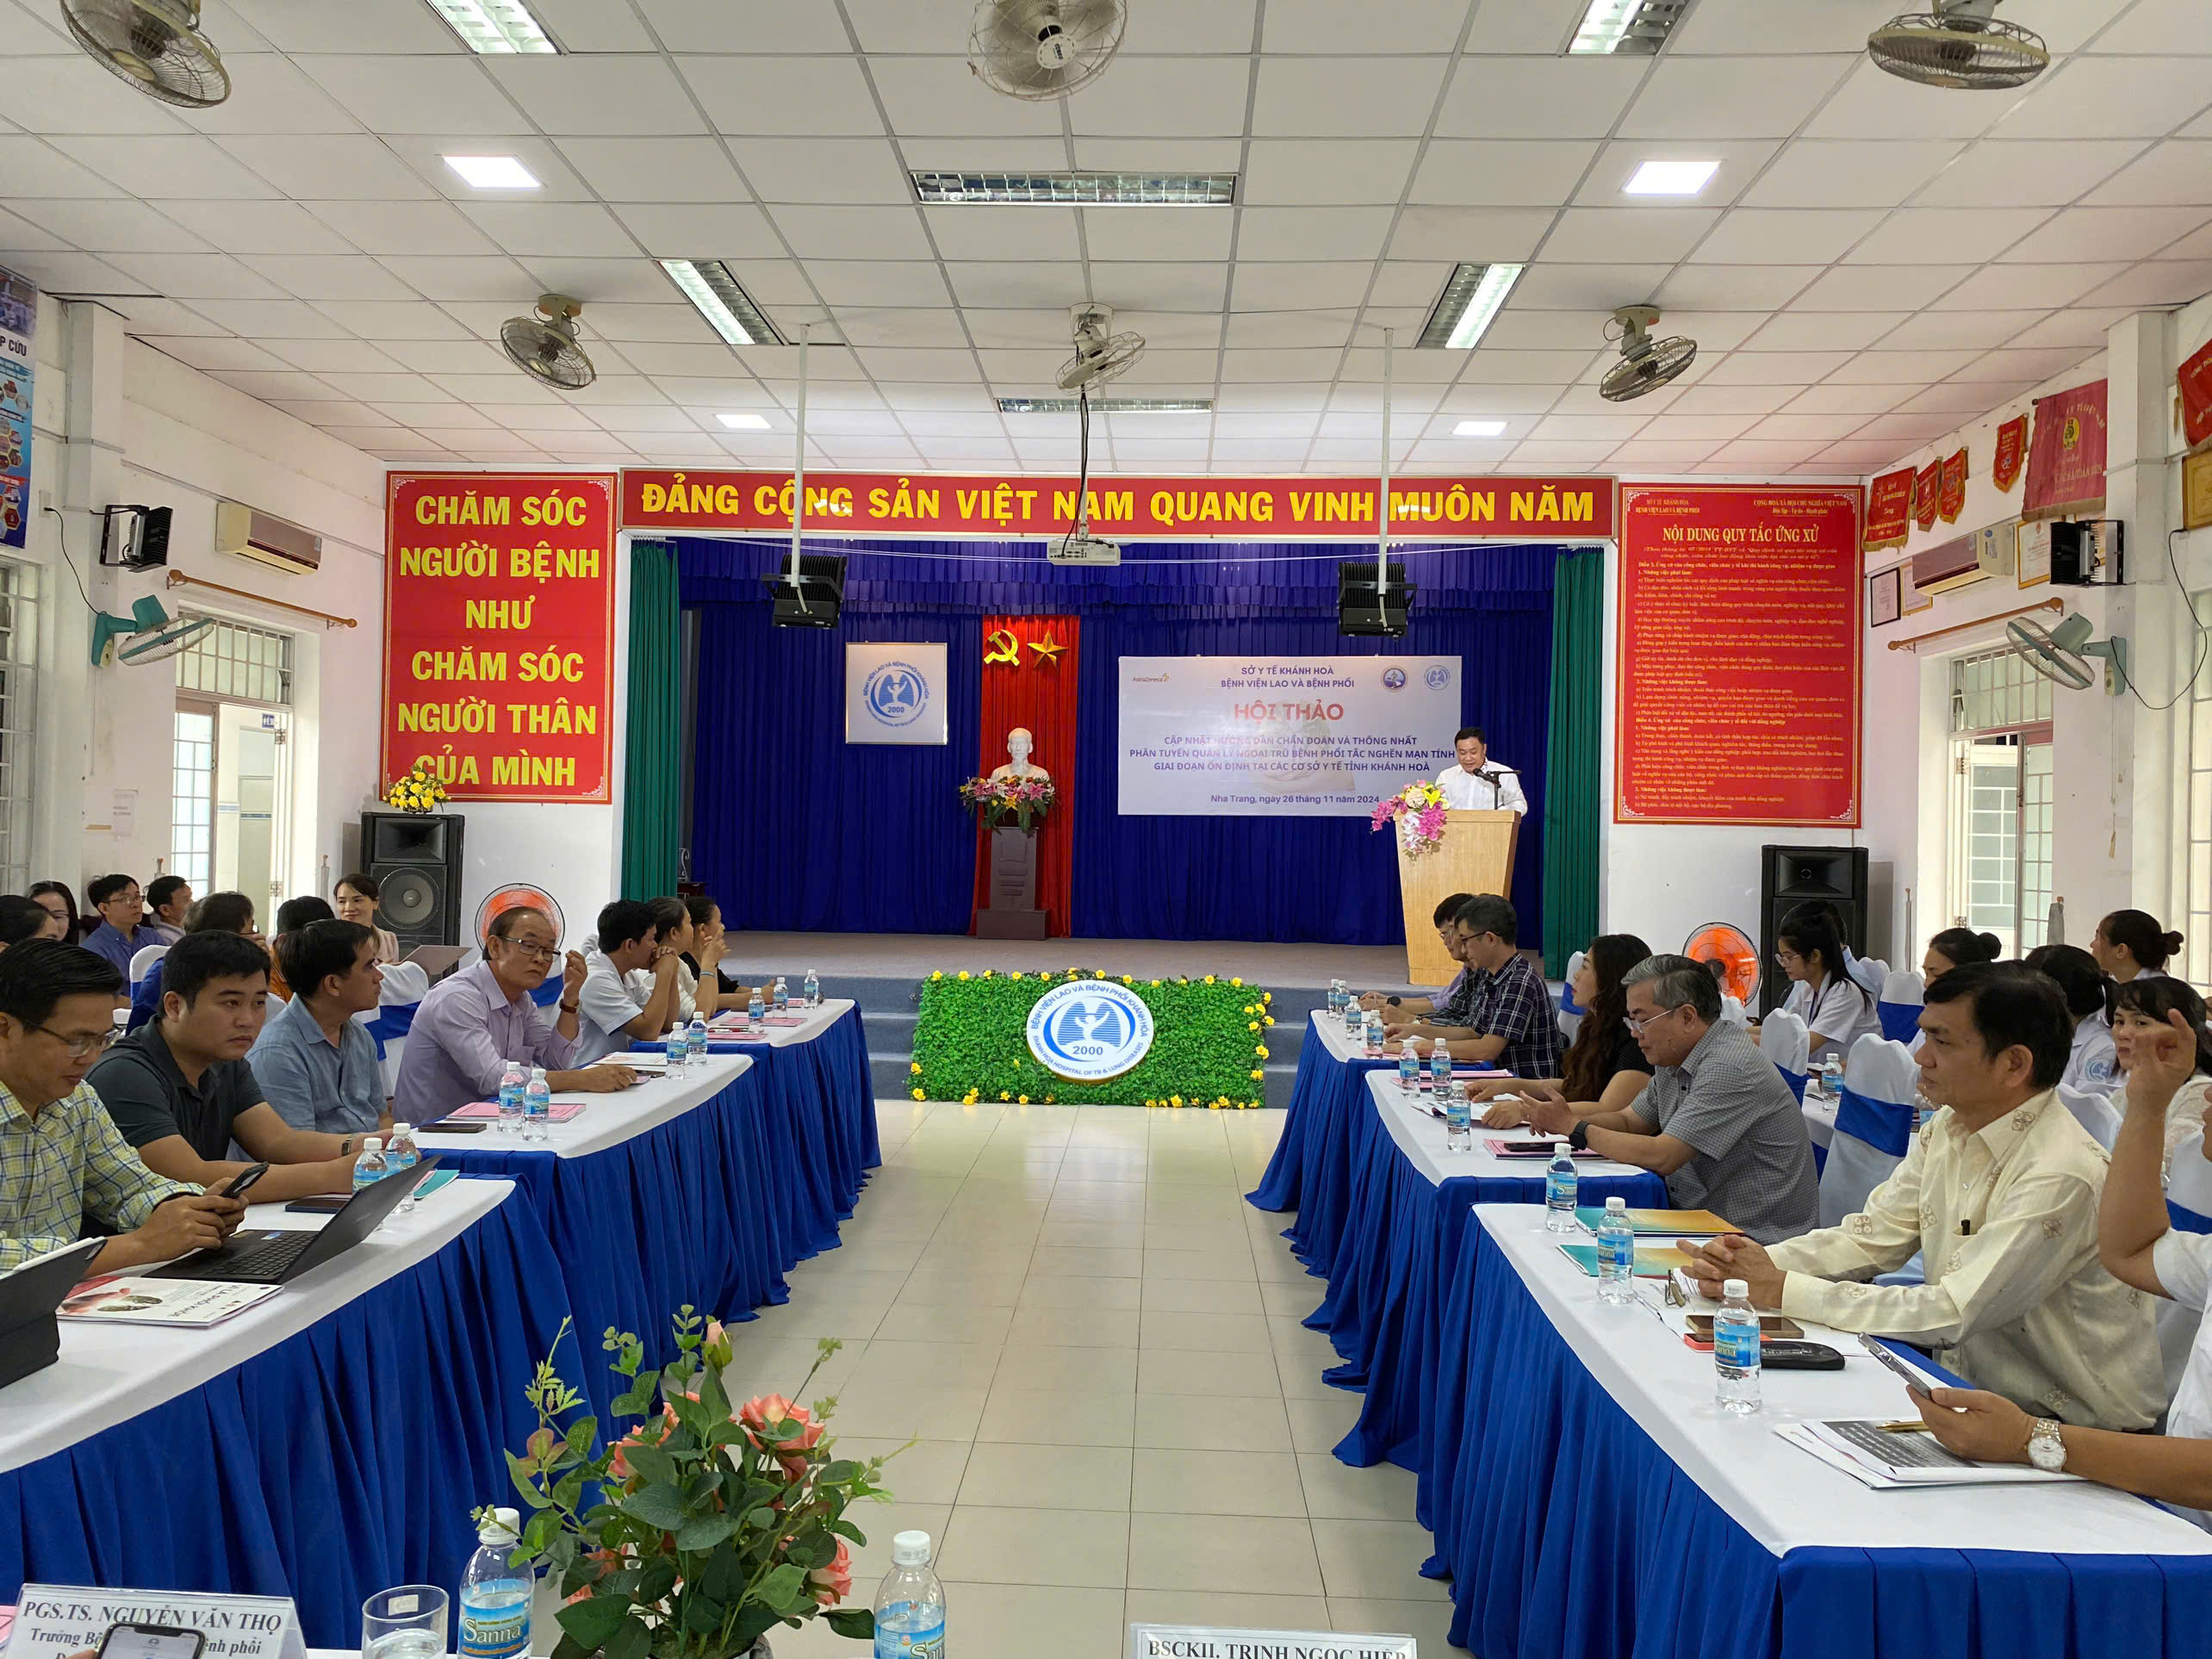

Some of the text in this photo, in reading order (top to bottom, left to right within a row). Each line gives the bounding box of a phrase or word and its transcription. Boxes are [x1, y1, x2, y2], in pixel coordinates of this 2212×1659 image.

[9, 339, 27, 357] CỨU
[416, 489, 587, 526] CHĂM SÓC
[642, 474, 1594, 527] ĐẢNG CỘNG SẢN VIỆT NAM QUANG VINH MUÔN NĂM
[1662, 521, 1819, 544] NỘI DUNG QUY TẮC ỨNG XỬ
[401, 540, 600, 583] NGƯỜI BỆNH
[465, 595, 536, 631] NHƯ
[413, 644, 584, 683] CHĂM SÓC
[1241, 665, 1334, 675] SỞ Y TẾ KHÁNH HOÀ
[1221, 678, 1244, 689] BỆNH
[1246, 678, 1268, 689] VIỆN
[1291, 678, 1304, 687] VÀ
[1307, 678, 1330, 689] BỆNH
[1333, 677, 1355, 687] PHỔI
[398, 694, 597, 735] NGƯỜI THÂN
[1234, 699, 1344, 725] HỘI THẢO
[1165, 736, 1183, 746] CẬP
[1185, 736, 1211, 746] NHẬT
[1307, 735, 1335, 745] ĐOÁN
[1338, 736, 1351, 745] VÀ
[1353, 734, 1387, 745] THỐNG
[1390, 734, 1418, 745] NHẤT
[415, 743, 575, 786] CỦA MÌNH
[1130, 748, 1156, 757] PHÂN
[1159, 748, 1190, 758] TUYẾN
[1292, 748, 1318, 760] BỆNH
[1320, 748, 1345, 758] PHỔI
[1347, 748, 1364, 758] TẮC
[1405, 750, 1428, 760] MẠN
[1431, 749, 1456, 759] TÍNH
[1154, 761, 1175, 770] GIAI
[1177, 762, 1204, 773] ĐOẠN
[1225, 762, 1249, 773] ĐỊNH
[1252, 762, 1268, 773] TẠI
[1270, 761, 1289, 771] CÁC
[1291, 762, 1305, 771] CƠ
[1307, 761, 1321, 771] SỞ
[1331, 761, 1342, 771] TẾ
[1344, 761, 1368, 772] TỈNH
[1370, 761, 1406, 772] KHÁNH
[1408, 761, 1430, 772] HOÀ
[1230, 796, 1257, 805] Trang,
[1259, 796, 1282, 805] ngày
[1295, 795, 1321, 805] tháng
[1031, 1010, 1044, 1028] BỆNH
[1040, 997, 1056, 1010] VIỆN
[1054, 989, 1072, 999] LAO
[1085, 984, 1109, 992] BỆNH
[1109, 988, 1128, 1000] PHỔI
[1127, 999, 1146, 1022] KHÁNH
[1072, 1046, 1103, 1056] 2000
[1716, 1343, 1737, 1357] anna
[22, 1601, 282, 1637] PGS.TS. NGUYỄN VĂN THỌ
[463, 1618, 521, 1643] Sanna
[31, 1628, 81, 1649] Trưởng
[229, 1637, 262, 1657] phổi
[1149, 1640, 1220, 1659] BSCKII.
